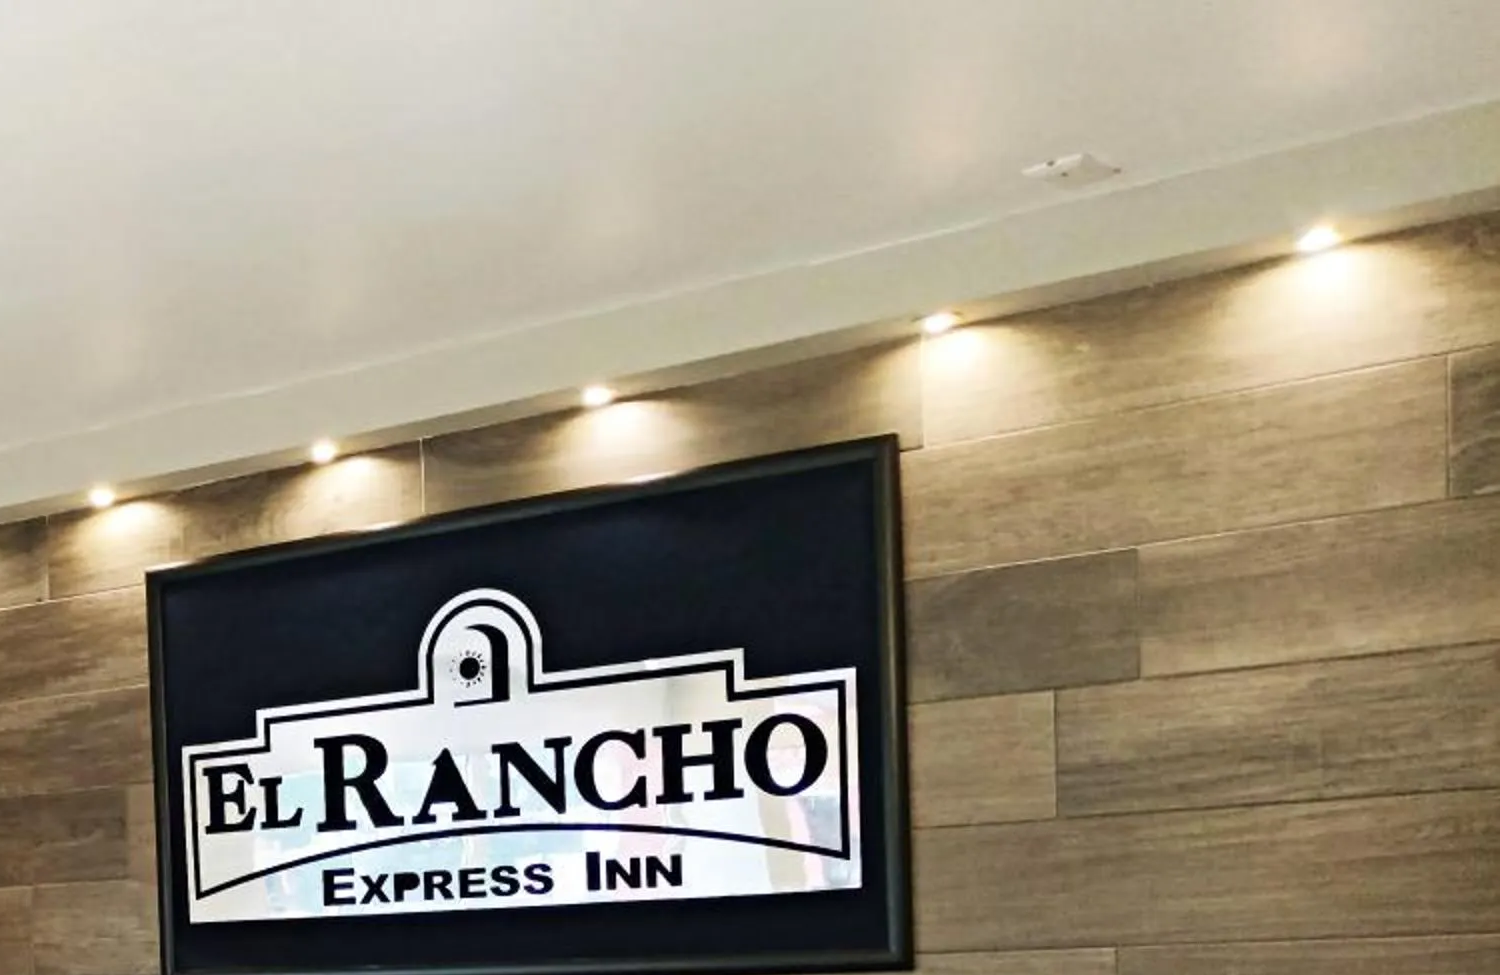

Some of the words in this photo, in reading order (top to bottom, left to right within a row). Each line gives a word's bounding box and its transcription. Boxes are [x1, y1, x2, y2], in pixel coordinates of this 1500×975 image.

[203, 763, 303, 834] EL
[314, 712, 829, 833] RANCHO
[323, 863, 554, 907] EXPRESS
[586, 851, 683, 891] INN
